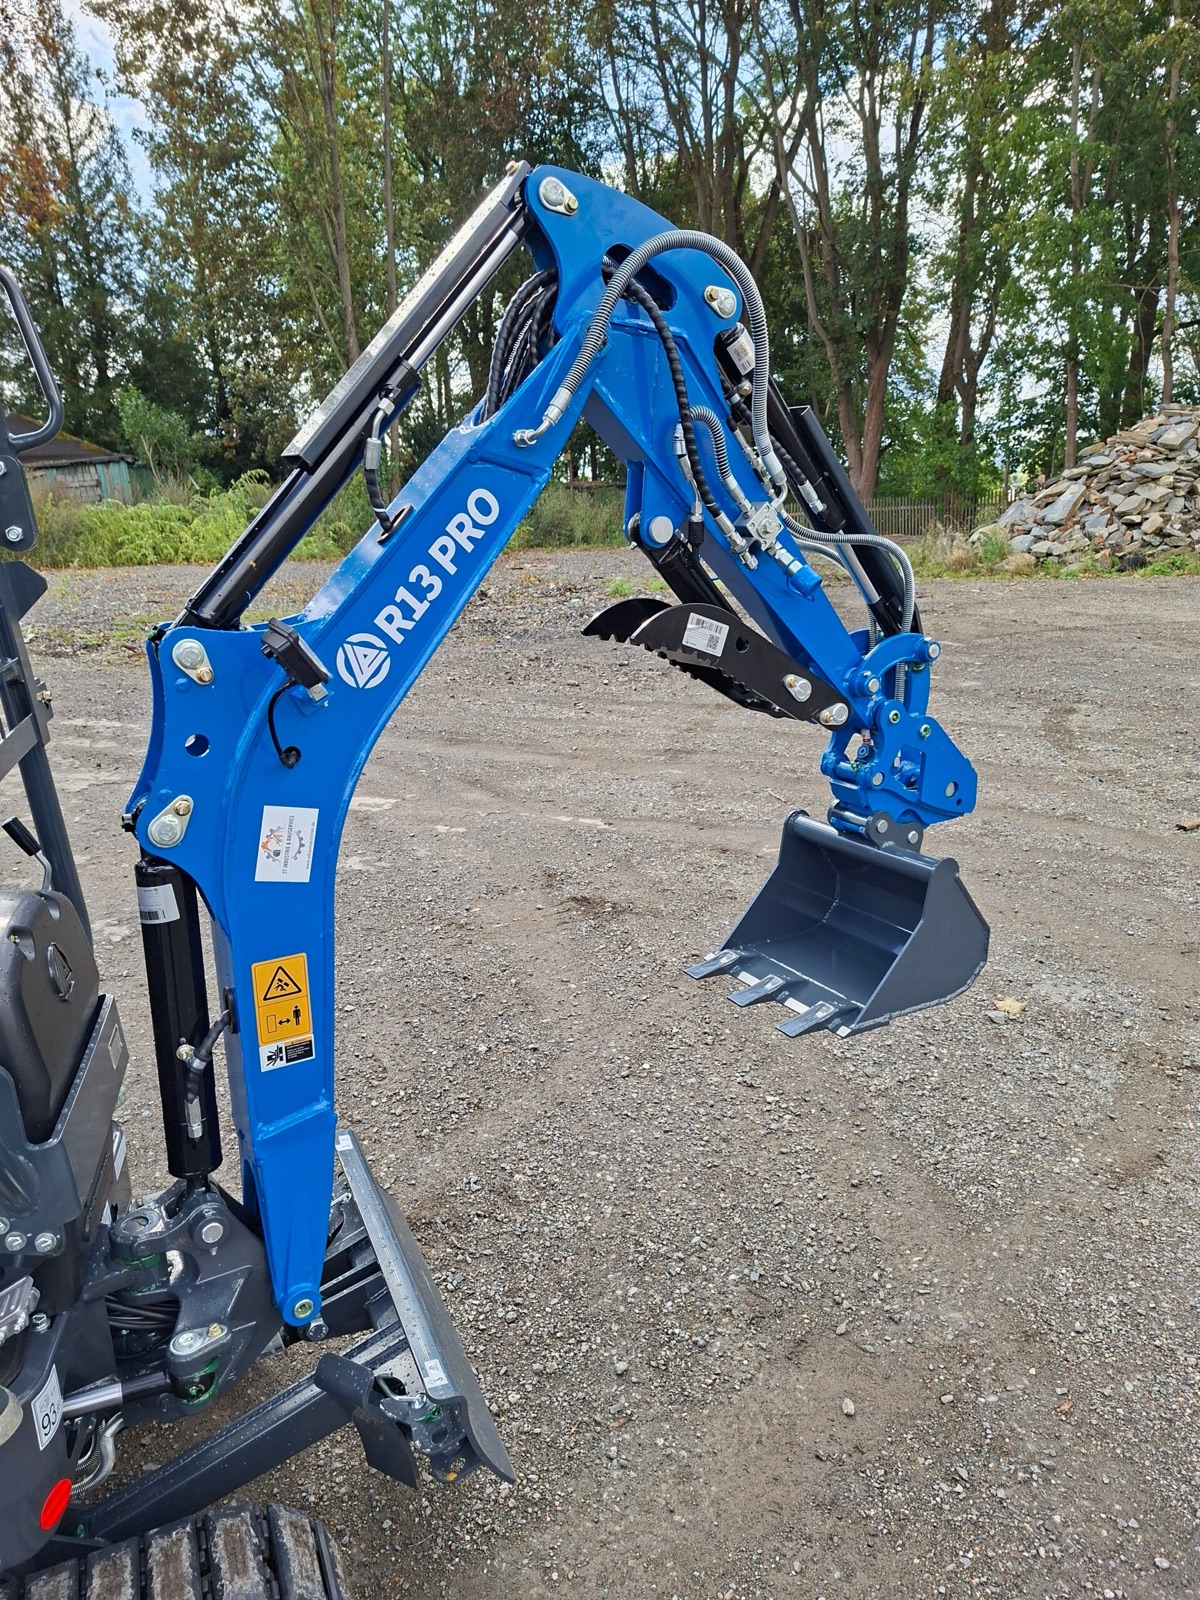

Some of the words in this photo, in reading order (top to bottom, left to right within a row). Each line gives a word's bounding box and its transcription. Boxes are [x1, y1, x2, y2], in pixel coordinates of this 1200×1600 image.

[373, 564, 443, 645] R13
[427, 488, 500, 576] PRO
[286, 815, 294, 841] BAUSERVICE
[41, 1403, 57, 1436] 93
